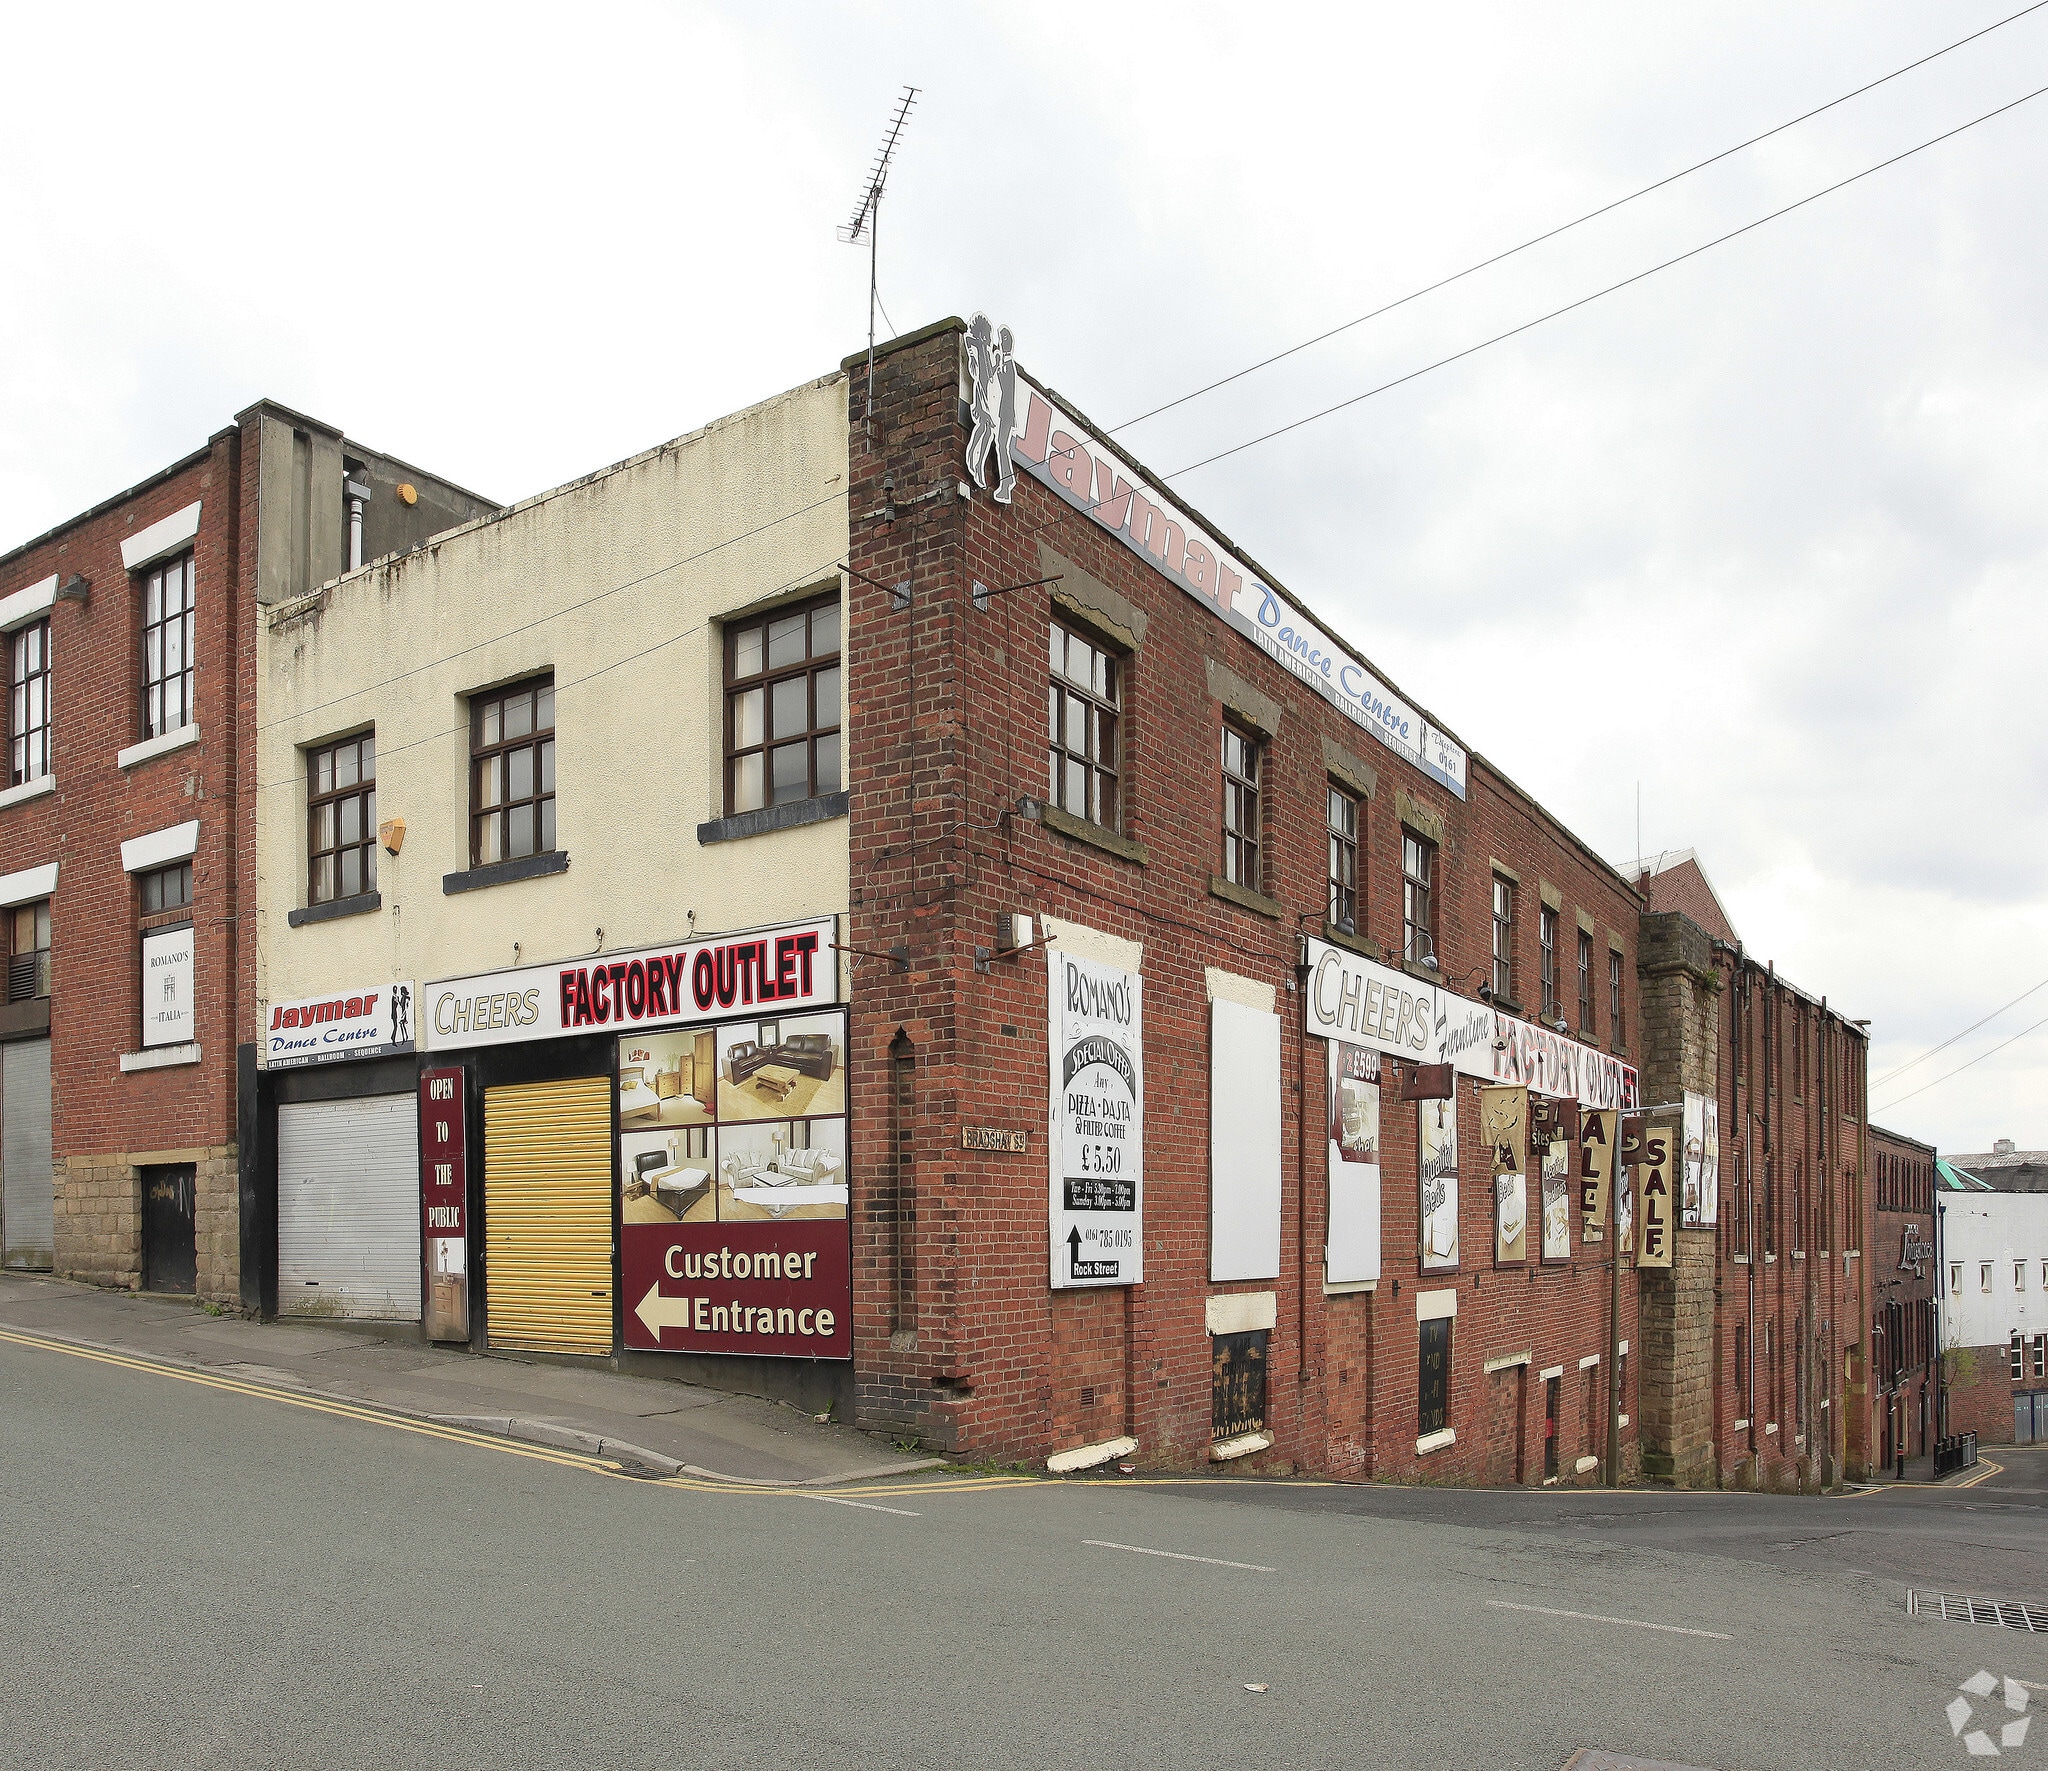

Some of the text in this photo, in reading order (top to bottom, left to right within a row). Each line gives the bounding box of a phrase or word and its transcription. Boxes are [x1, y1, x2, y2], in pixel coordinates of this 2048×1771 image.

[1015, 391, 1409, 740] Jaymar Dance Centre
[1252, 625, 1418, 766] LATIN AMERICAN BALLROOM SEQUENCE
[149, 950, 190, 968] ROMANO'S
[434, 930, 819, 1036] CHEERS FACTORY OUTLET
[1066, 961, 1132, 1026] ROMANO'S
[158, 1009, 181, 1023] ITALIA
[269, 993, 379, 1031] Jaymar
[268, 1027, 378, 1052] Dance Centre
[1313, 948, 1431, 1051] CHEERS
[1493, 1016, 1580, 1099] FACTORY
[1585, 1050, 1638, 1117] OUTLET
[282, 1056, 309, 1067] AMERICAN
[317, 1051, 345, 1063] BALLROOM
[353, 1046, 382, 1058] SEQUENCE
[1070, 1041, 1106, 1076] SPECIAL
[1353, 1050, 1378, 1081] £599
[429, 1077, 454, 1101] OPEN
[1093, 1071, 1109, 1093] Any
[1068, 1093, 1131, 1122] PIZZA PASTA
[435, 1120, 449, 1143] TO
[1083, 1119, 1103, 1137] FILTER
[1103, 1122, 1126, 1140] COFFEE
[434, 1163, 453, 1186] THE
[1072, 1193, 1093, 1209] Sunday
[1423, 1179, 1446, 1218] Beds
[428, 1205, 461, 1229] PUBLIC
[1085, 1228, 1132, 1248] 0161 785 0195
[664, 1244, 818, 1281] Customer
[1073, 1261, 1118, 1276] Rock Street
[694, 1296, 836, 1337] Entrance
